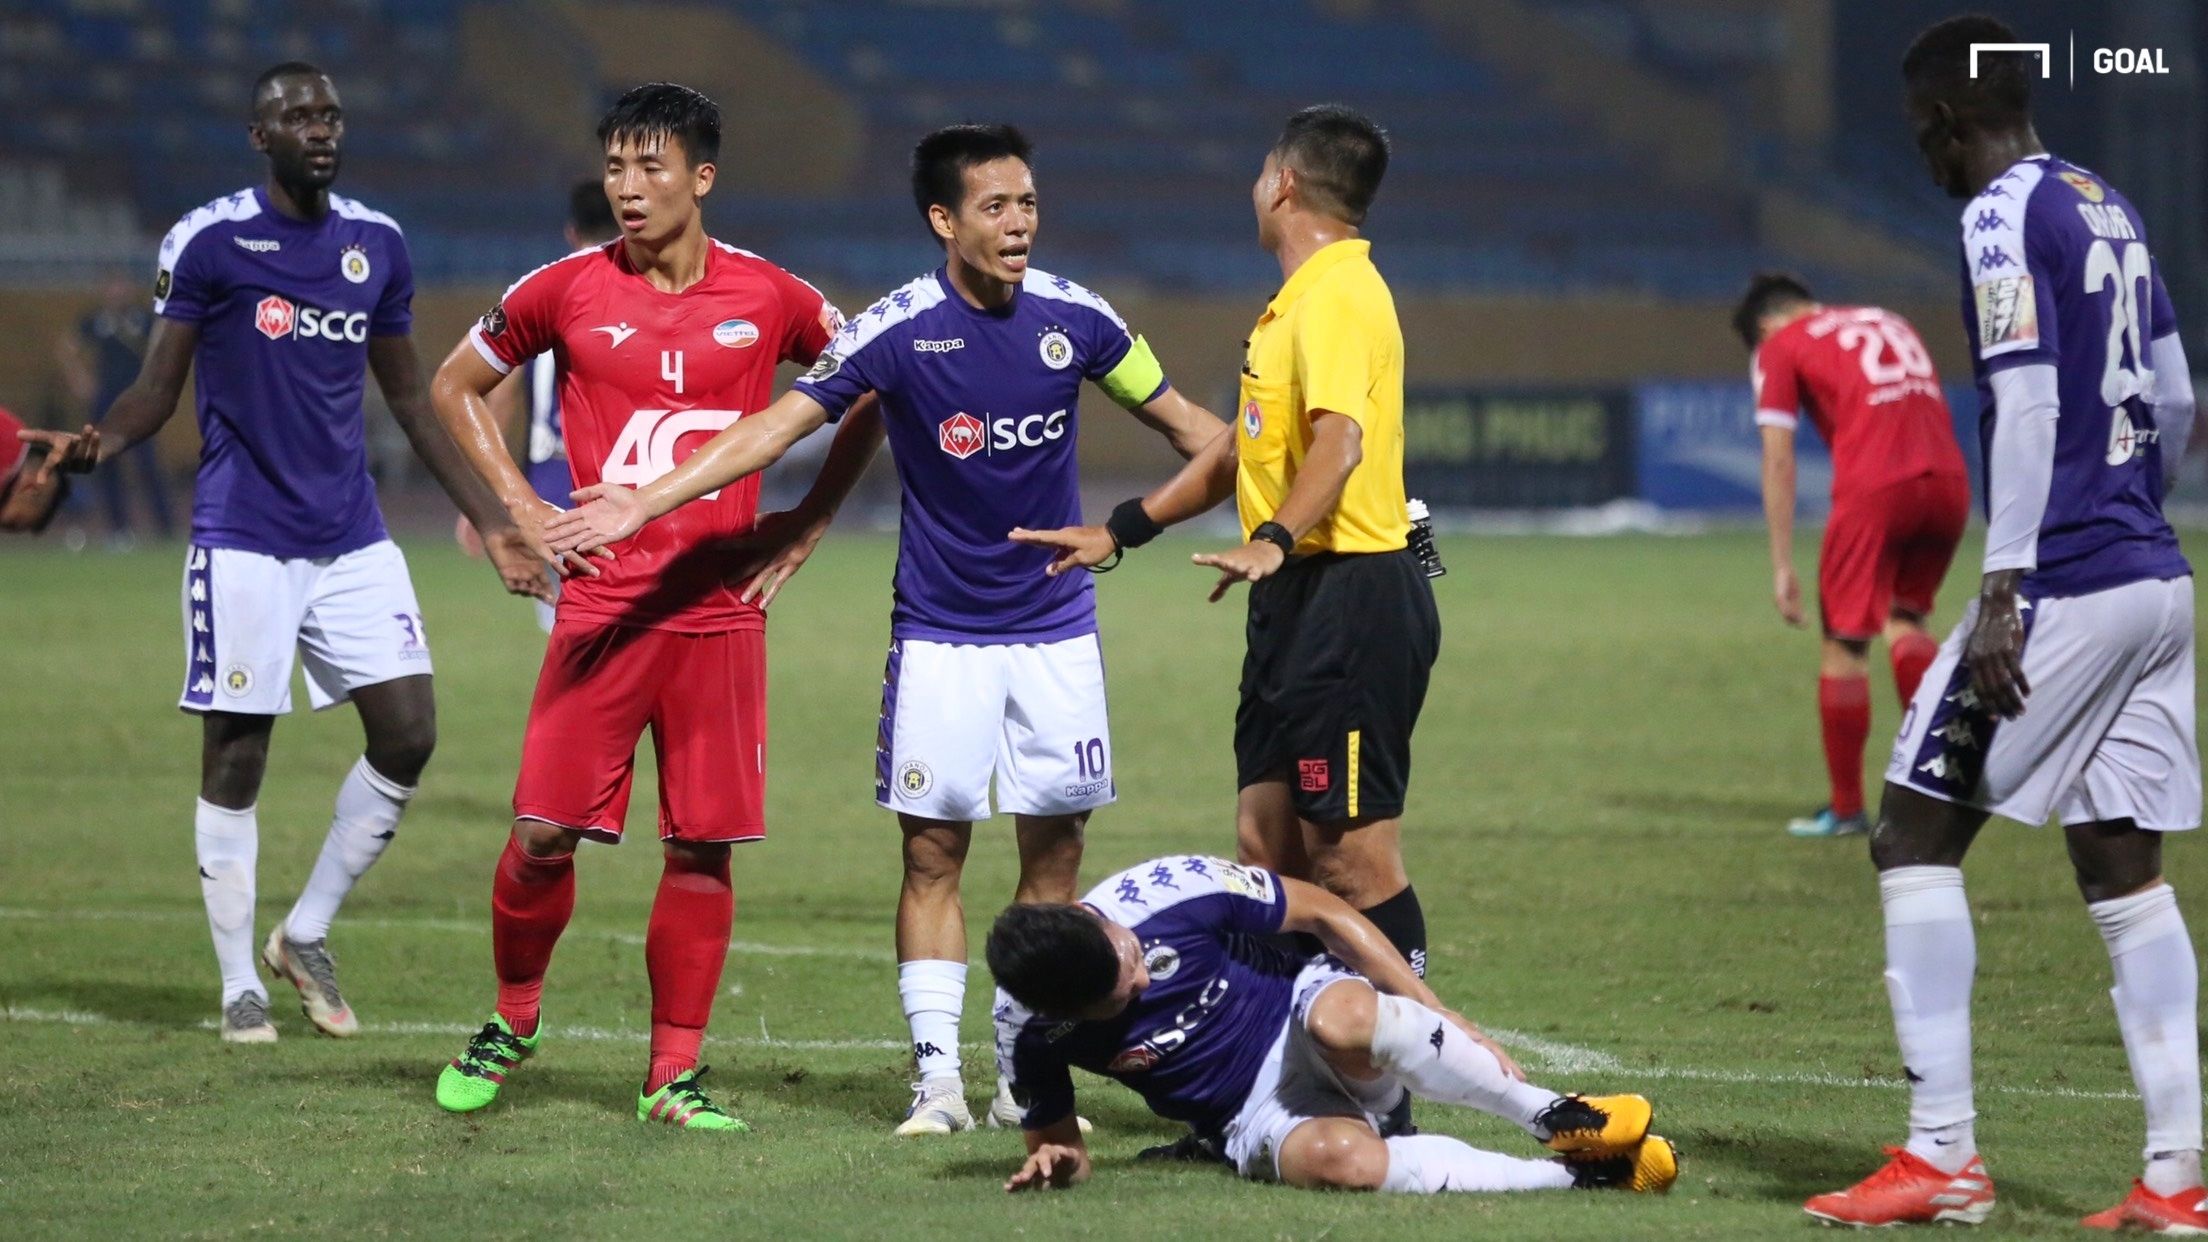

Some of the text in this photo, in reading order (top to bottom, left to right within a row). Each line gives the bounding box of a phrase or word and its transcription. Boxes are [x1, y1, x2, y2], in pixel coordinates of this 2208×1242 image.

[298, 307, 368, 343] SCG
[2084, 239, 2156, 408] 20
[913, 338, 965, 353] Kappa
[661, 350, 684, 394] 4
[993, 409, 1067, 451] SCG
[1074, 737, 1105, 782] 10
[1065, 778, 1109, 798] Kappa
[1152, 976, 1229, 1052] SCG
